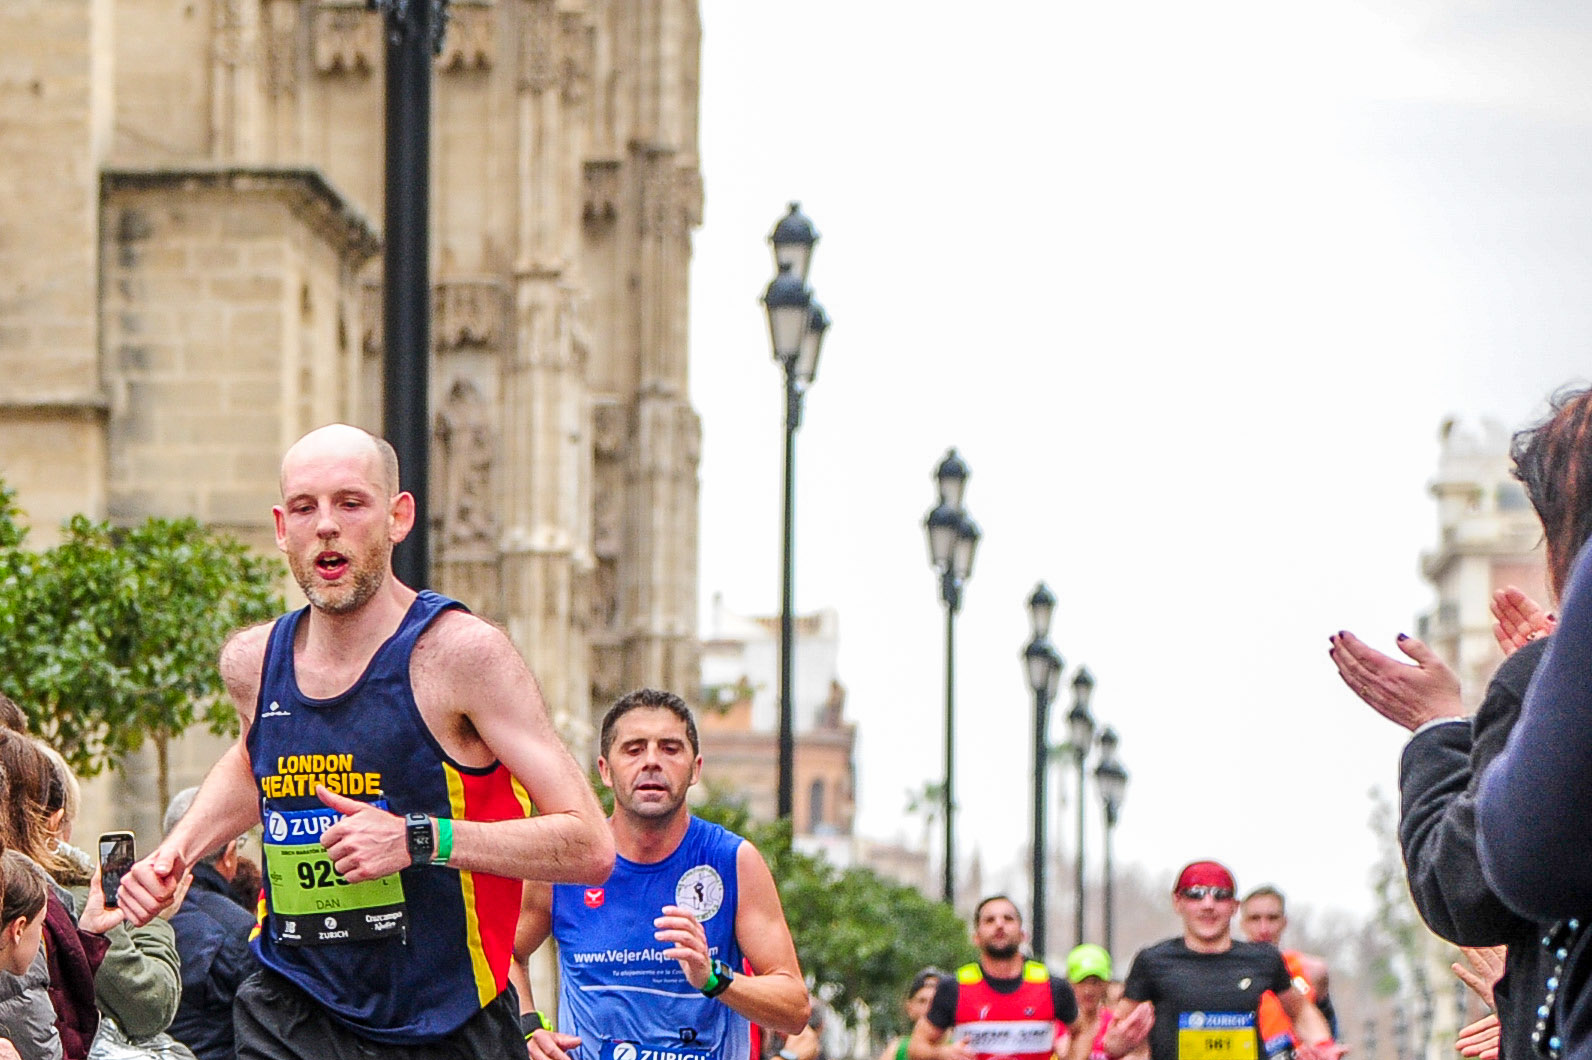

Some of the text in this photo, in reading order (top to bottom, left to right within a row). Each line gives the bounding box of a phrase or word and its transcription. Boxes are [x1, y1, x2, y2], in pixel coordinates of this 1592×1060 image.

[278, 754, 353, 775] LONDON
[261, 772, 381, 798] HEATHSIDE
[290, 814, 348, 836] ZUR
[316, 899, 341, 910] DAN
[319, 930, 349, 940] ZURICH
